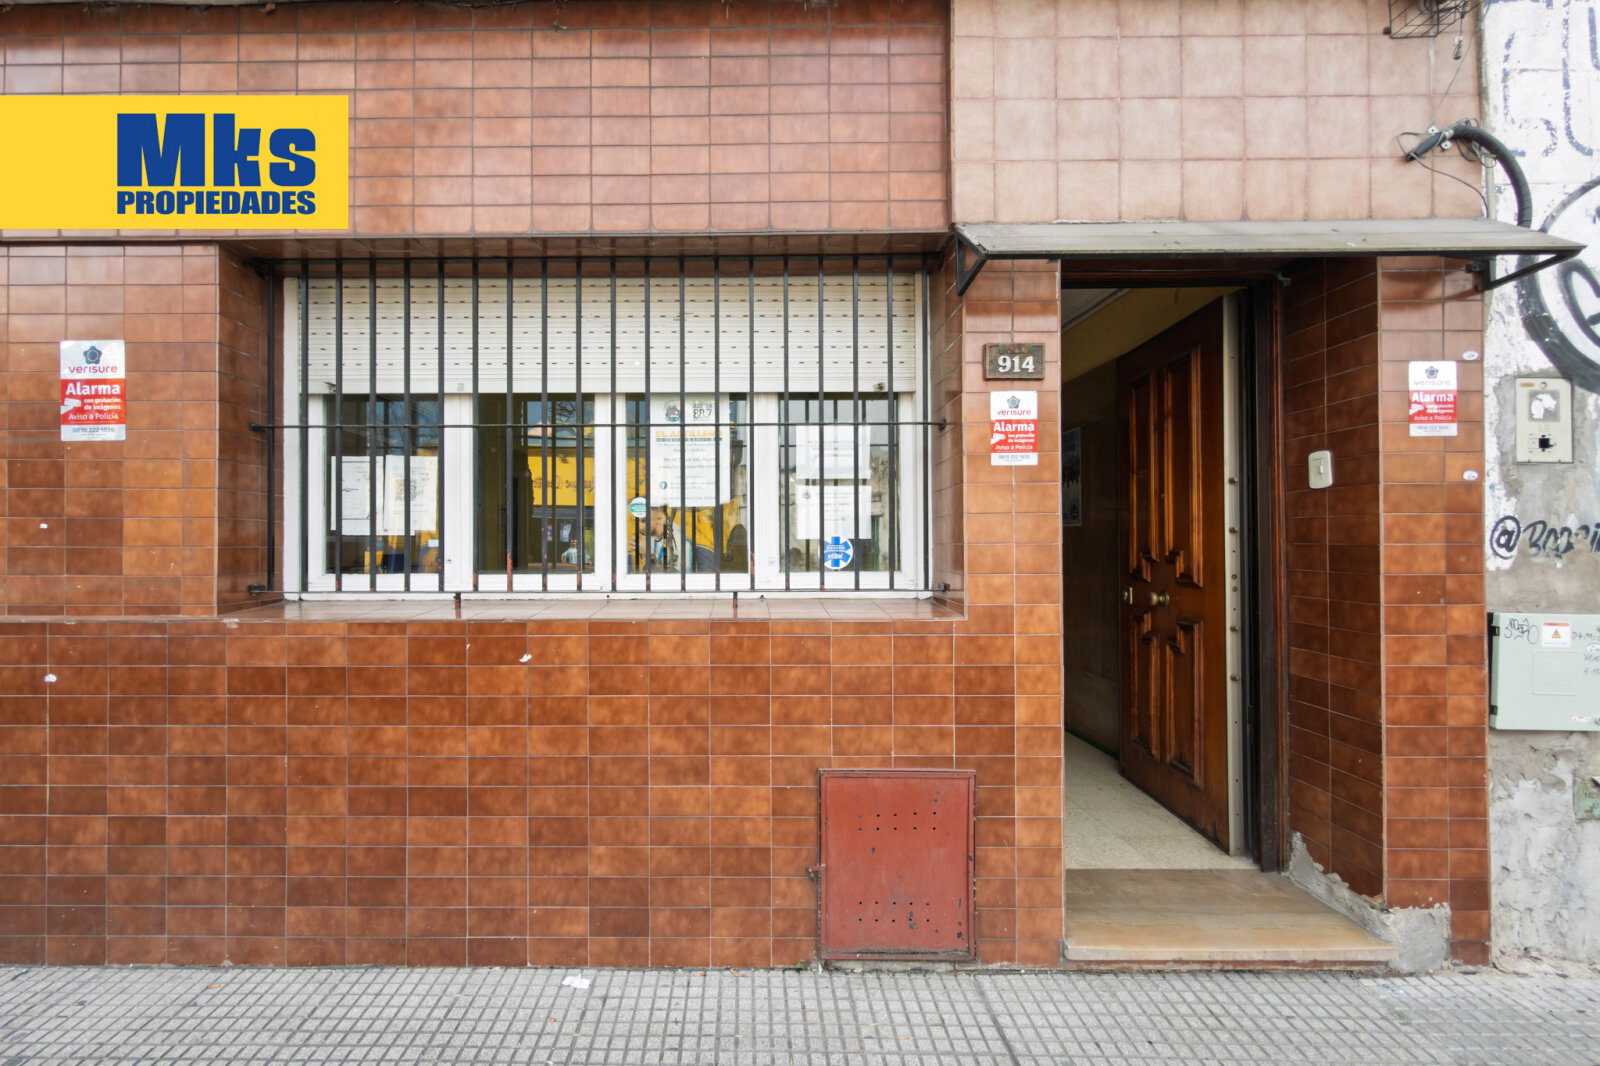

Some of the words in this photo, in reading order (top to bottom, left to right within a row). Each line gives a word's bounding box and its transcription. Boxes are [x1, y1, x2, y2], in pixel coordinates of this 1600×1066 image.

[68, 365, 118, 374] verisure
[997, 355, 1035, 373] 914
[65, 381, 121, 395] Alarma
[1411, 392, 1454, 403] Alarma
[993, 422, 1035, 432] Alarma
